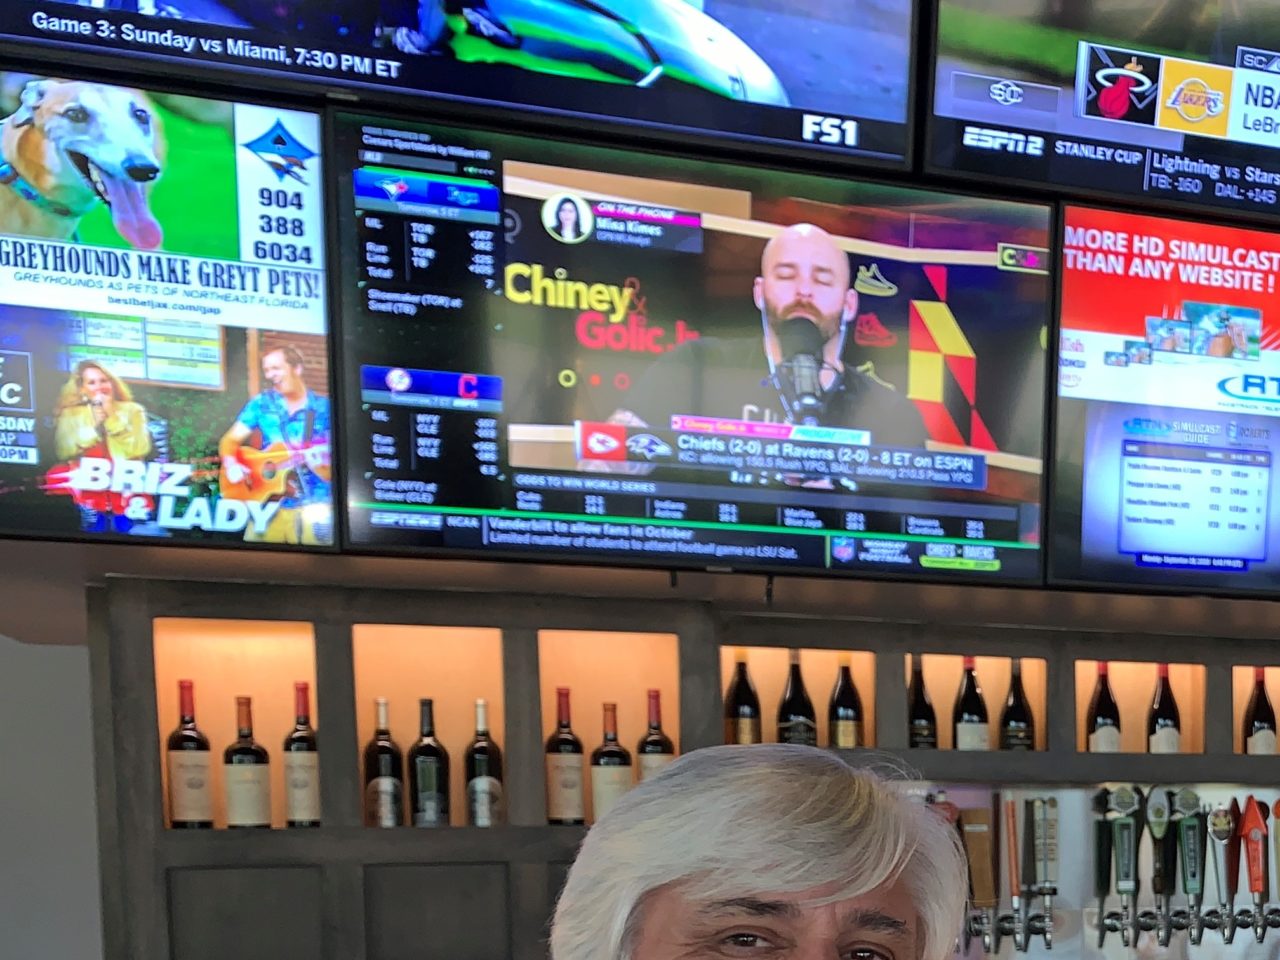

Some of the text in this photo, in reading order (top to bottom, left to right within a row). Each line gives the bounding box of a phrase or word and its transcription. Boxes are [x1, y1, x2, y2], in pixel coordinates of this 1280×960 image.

[32, 12, 401, 78] Game 3: Sunday vs Miami, 7:30 PM ET
[1243, 54, 1267, 68] SC
[802, 114, 859, 147] FS1
[963, 126, 1044, 155] ESPN2
[1055, 140, 1142, 164] STANLEY CUP
[1153, 152, 1220, 180] Lightning
[1224, 166, 1240, 179] vs
[258, 188, 304, 211] 904
[259, 214, 304, 237] 388
[1064, 226, 1128, 253] MORE
[1133, 235, 1165, 257] HD
[0, 240, 320, 298] GREYHOUNDS MAKE GREYT PETS!
[253, 241, 312, 264] 6034
[1063, 248, 1263, 292] THAN ANY WEBSITE
[14, 272, 309, 310] GREYHOUNDS AS PETS OF NORTHEAST FLORIDA
[504, 262, 634, 323] Chiney
[575, 310, 665, 354] Golic
[74, 456, 194, 497] BRIZ
[124, 495, 282, 534] & LADY
